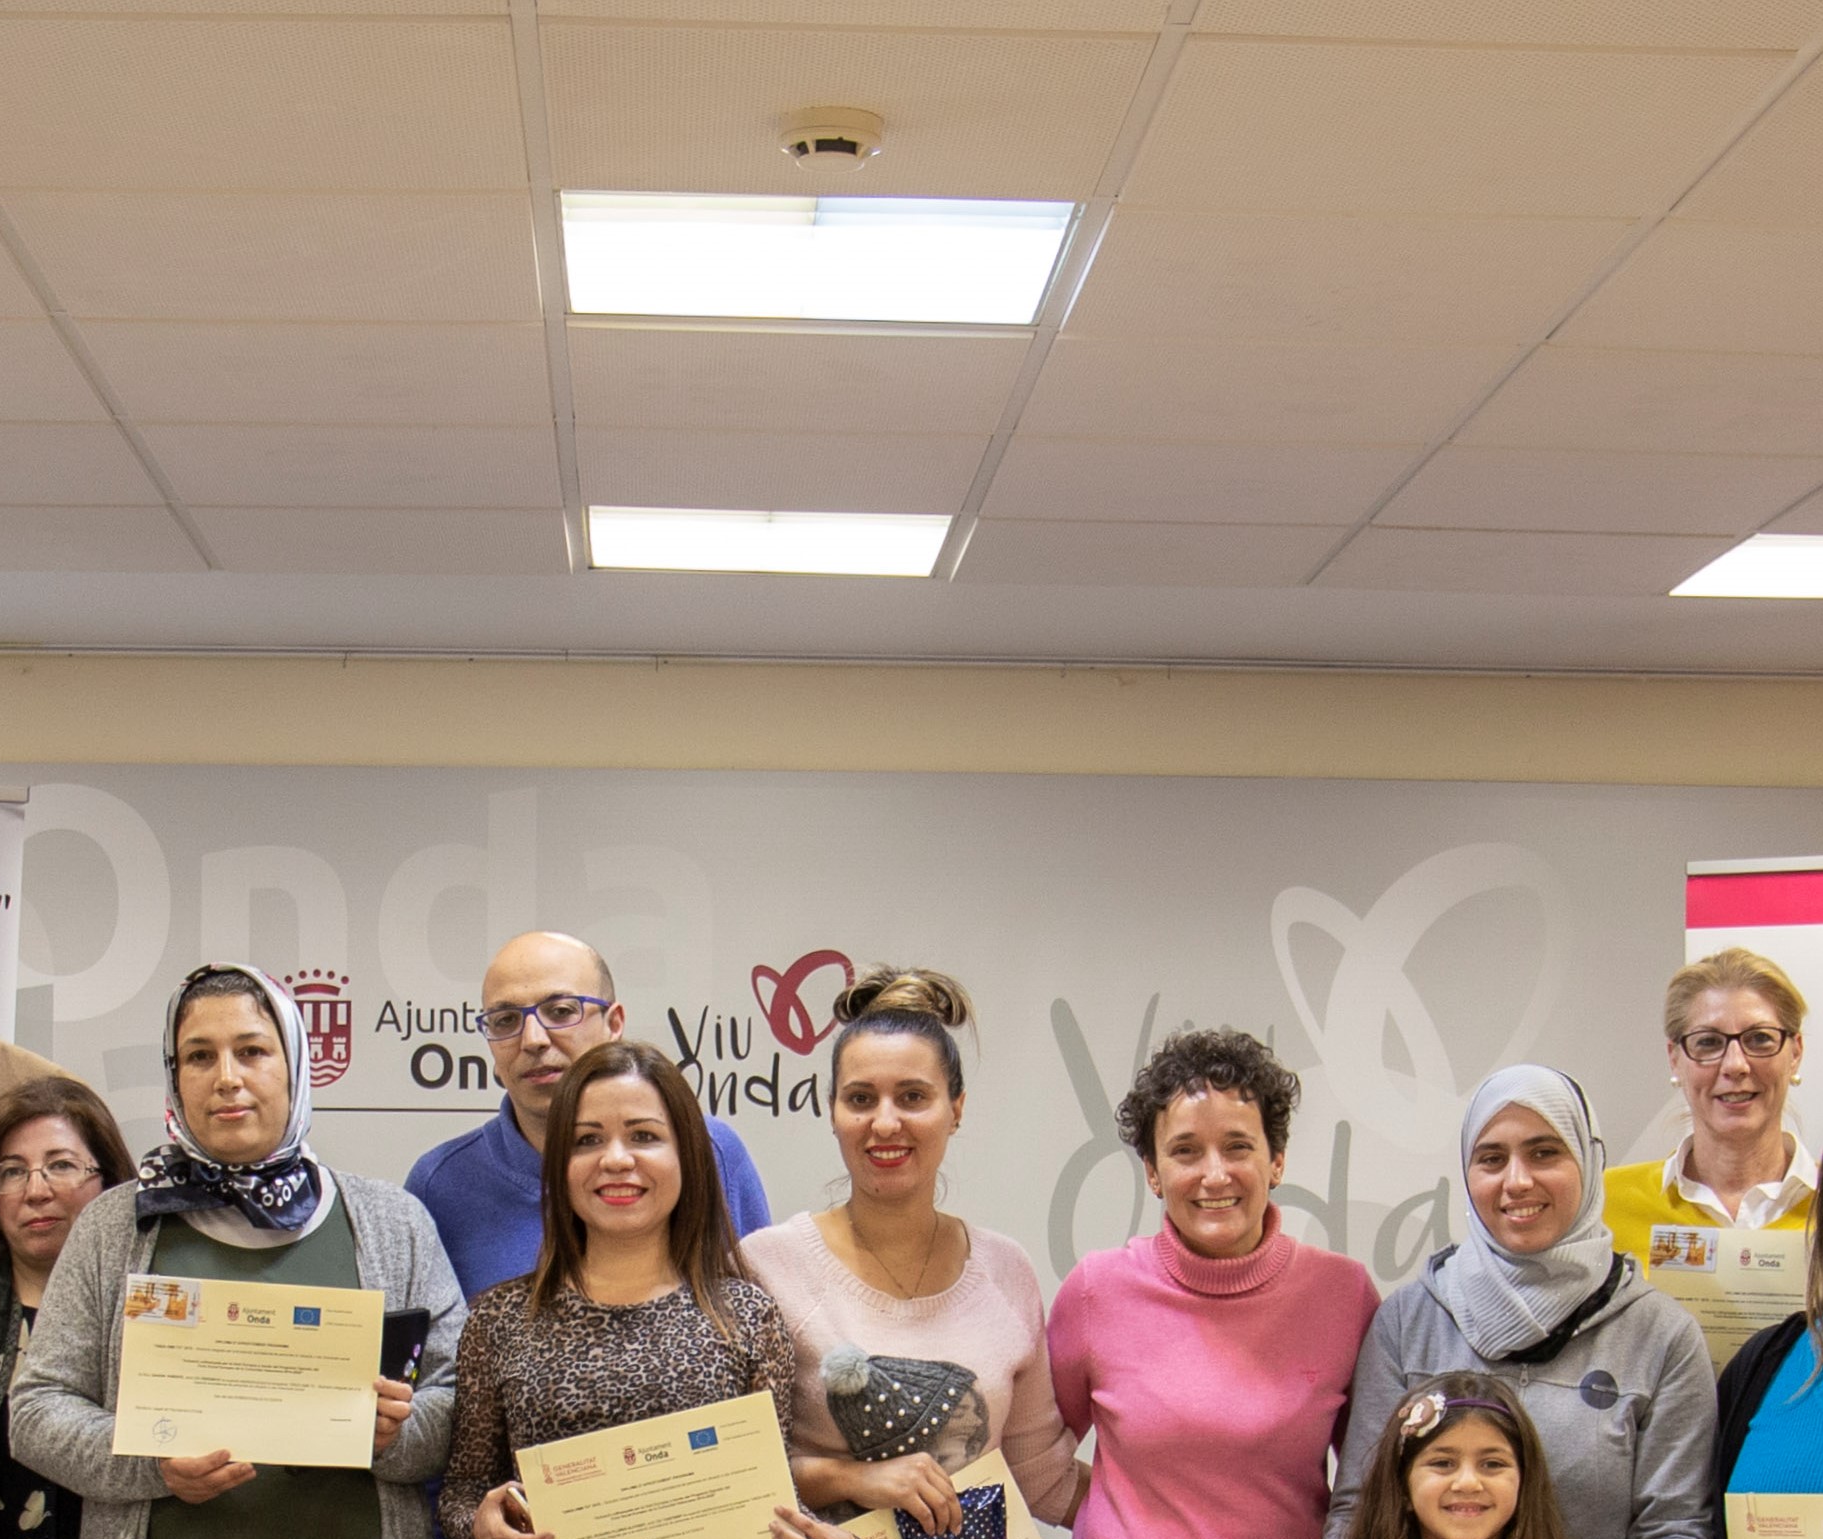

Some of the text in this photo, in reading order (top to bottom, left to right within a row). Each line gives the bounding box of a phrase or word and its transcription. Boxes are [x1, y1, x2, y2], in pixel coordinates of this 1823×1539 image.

[667, 1005, 752, 1060] Viu
[676, 1052, 822, 1118] Onda
[246, 1315, 272, 1325] Onda
[644, 1450, 669, 1463] Onda
